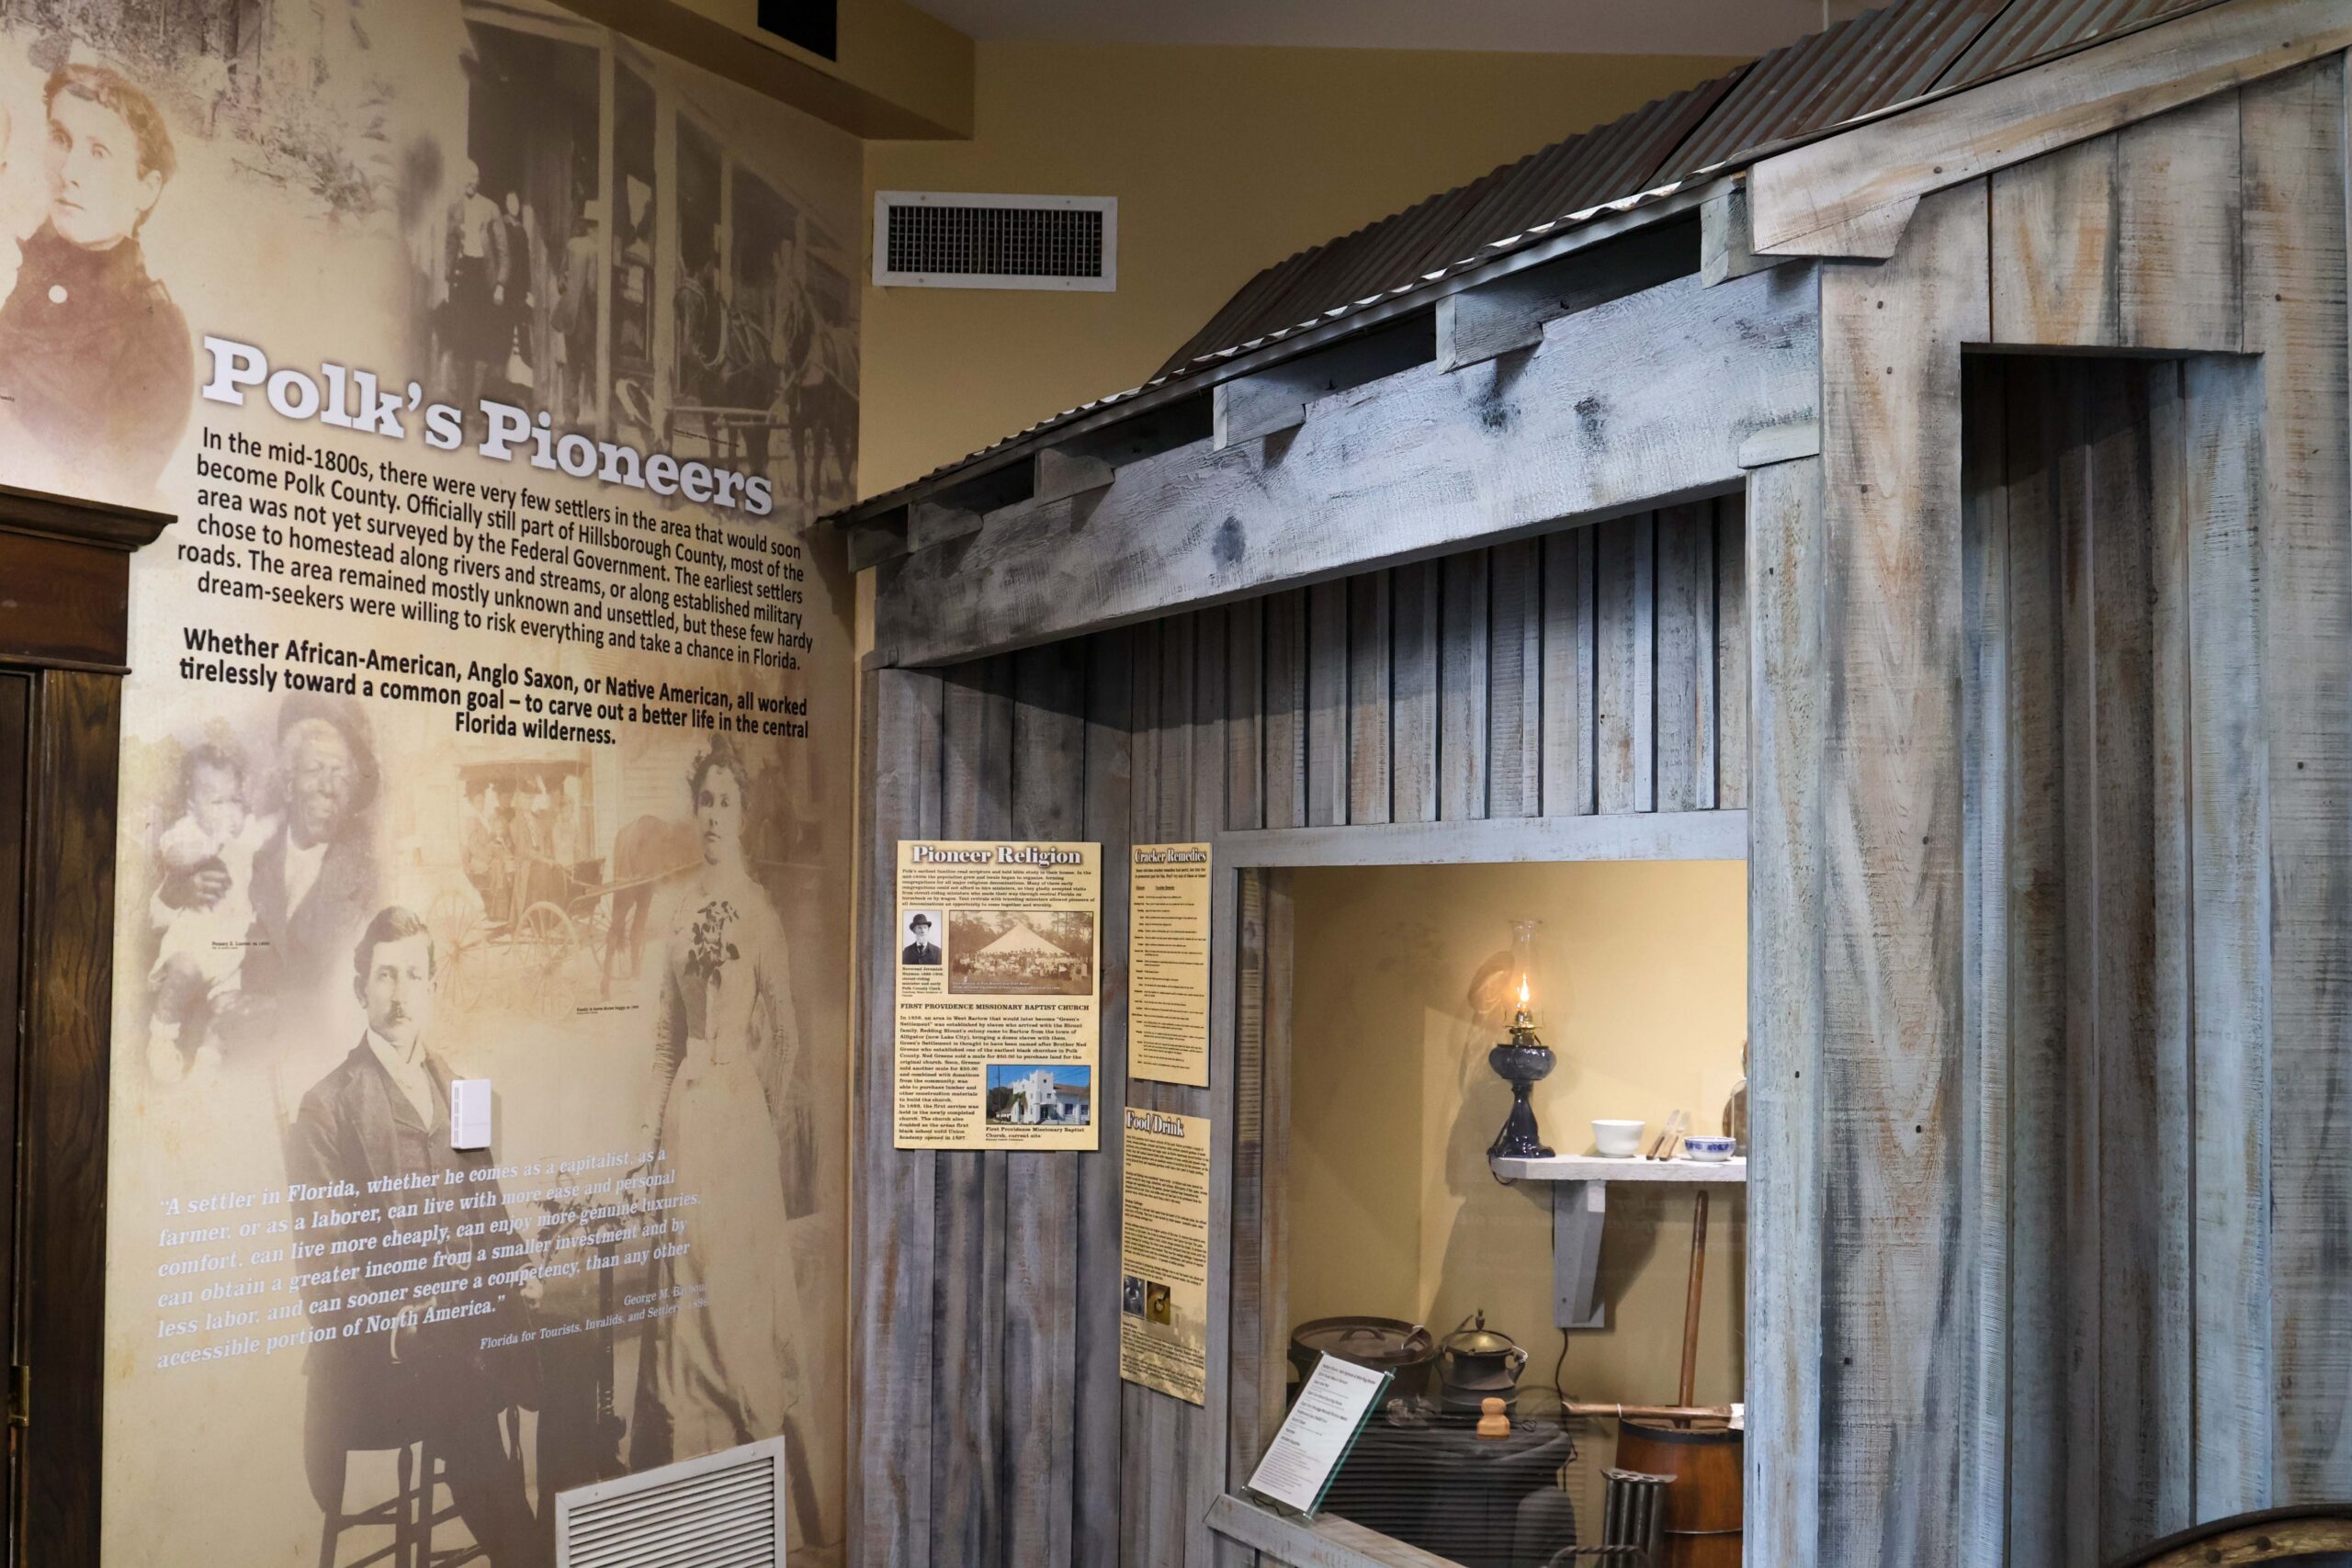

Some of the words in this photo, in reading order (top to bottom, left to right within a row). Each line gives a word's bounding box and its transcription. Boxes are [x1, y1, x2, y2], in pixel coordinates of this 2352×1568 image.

[202, 335, 463, 449] Polk's
[479, 399, 774, 516] Pioneers
[197, 453, 277, 489] become
[284, 470, 325, 498] Polk
[331, 479, 401, 514] County.
[407, 493, 483, 529] Officially
[487, 509, 515, 531] still
[521, 518, 554, 538] part
[558, 521, 575, 541] of
[579, 524, 672, 561] Hillsborough
[675, 543, 727, 571] County,
[730, 557, 763, 575] most
[766, 560, 781, 578] of
[783, 563, 804, 582] the
[203, 426, 221, 450] In
[228, 432, 262, 457] the
[268, 442, 374, 482] mid-1800s,
[379, 460, 427, 489] there
[432, 476, 476, 498] were
[481, 485, 516, 510] very
[520, 488, 550, 512] few
[555, 499, 611, 524] settlers
[615, 506, 628, 526] in
[632, 510, 657, 532] the
[661, 520, 691, 538] area
[695, 523, 723, 545] that
[727, 533, 767, 553] would
[771, 542, 800, 559] soon
[198, 489, 243, 512] area
[249, 497, 288, 519] was
[294, 505, 327, 525] not
[332, 511, 362, 533] yet
[367, 517, 447, 547] surveyed
[453, 526, 474, 554] by
[478, 532, 506, 555] the
[511, 537, 569, 565] Federal
[573, 548, 671, 582] Government.
[674, 566, 700, 587] The
[704, 573, 753, 596] earliest
[756, 583, 802, 604] settlers
[198, 513, 256, 542] chose
[262, 525, 283, 547] to
[289, 525, 394, 563] homestead
[400, 546, 449, 577] along
[454, 554, 501, 580] rivers
[504, 565, 535, 585] and
[539, 570, 605, 600] streams,
[610, 583, 627, 599] or
[629, 582, 670, 610] along
[673, 592, 750, 618] established
[753, 604, 802, 630] military
[198, 570, 344, 611] dream-seekers
[349, 596, 396, 617] were
[401, 600, 459, 631] willing
[463, 609, 481, 629] to
[487, 611, 516, 634] risk
[520, 620, 605, 649] everything
[608, 629, 636, 649] and
[639, 633, 671, 653] take
[674, 641, 683, 655] a
[686, 638, 734, 661] chance
[738, 645, 750, 664] in
[753, 648, 800, 671] Florida.
[179, 656, 278, 693] tirelessly
[283, 669, 356, 695] toward
[362, 680, 374, 697] a
[379, 682, 461, 705] common
[466, 689, 504, 711] goal
[525, 694, 543, 714] to
[548, 699, 593, 718] carve
[597, 703, 624, 721] out
[628, 707, 637, 722] a
[642, 703, 688, 727] better
[692, 708, 715, 729] life
[718, 711, 731, 731] in
[736, 714, 759, 734] the
[763, 720, 808, 739] central
[183, 626, 279, 660] Whether
[285, 639, 462, 683] African-American,
[467, 660, 519, 689] Anglo
[524, 667, 579, 695] Saxon,
[583, 678, 602, 694] or
[605, 676, 655, 700] Native
[659, 682, 733, 712] American,
[737, 691, 753, 711] all
[758, 695, 807, 716] worked
[456, 712, 516, 736] Florida
[523, 719, 616, 744] wilderness.
[912, 845, 992, 863] Pioneer
[997, 846, 1082, 867] Religion
[1134, 848, 1167, 864] Cracker
[1167, 847, 1207, 864] Remedies
[1125, 1109, 1185, 1138] Food/Drink
[187, 1191, 255, 1213] settler
[262, 1189, 280, 1205] in
[287, 1180, 361, 1202] Florida,
[367, 1171, 441, 1194] whether
[445, 1168, 465, 1187] he
[469, 1166, 518, 1182] comes
[524, 1163, 541, 1176] as
[546, 1162, 556, 1174] a
[639, 1150, 654, 1163] as
[658, 1148, 666, 1160] a
[157, 1291, 193, 1308] can
[200, 1278, 266, 1303] obtain
[272, 1279, 282, 1291] a
[288, 1265, 359, 1294] greater
[365, 1257, 427, 1278] income
[433, 1249, 472, 1269] from
[477, 1250, 487, 1262] a
[492, 1235, 551, 1260] smaller
[555, 1225, 638, 1251] investment
[642, 1219, 667, 1237] and
[672, 1217, 687, 1235] by
[157, 1333, 260, 1369] accessible
[265, 1321, 340, 1356] portion
[342, 1317, 363, 1337] of
[365, 1306, 419, 1334] North
